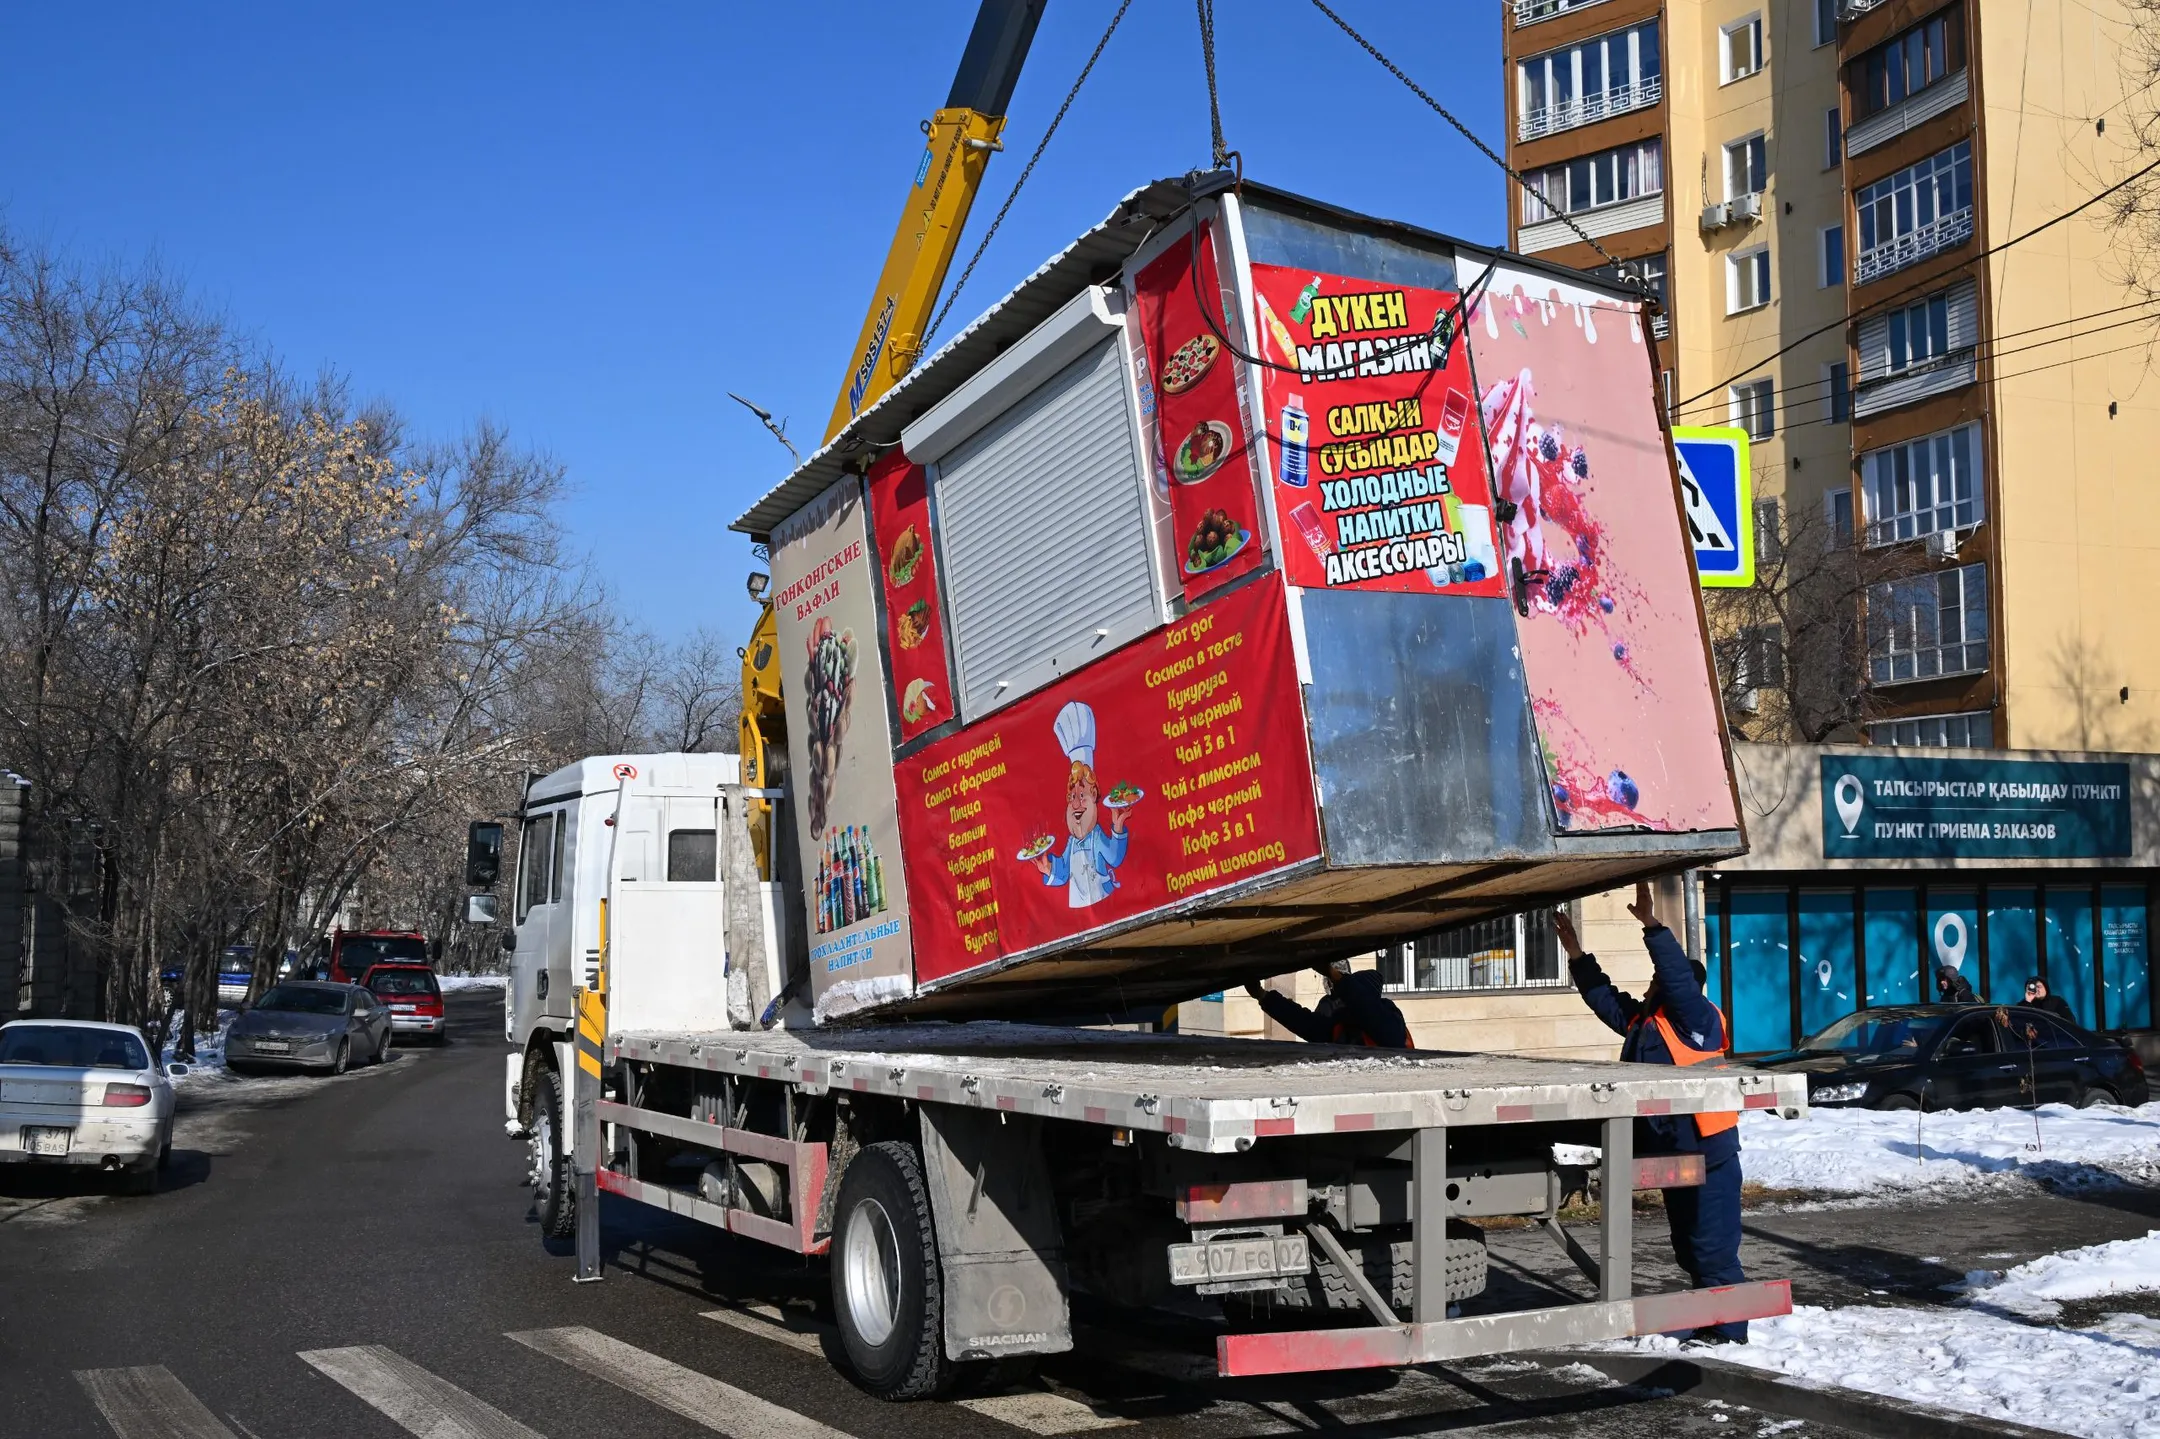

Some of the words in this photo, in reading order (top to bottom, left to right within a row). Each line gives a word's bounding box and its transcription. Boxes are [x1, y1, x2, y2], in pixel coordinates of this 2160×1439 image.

[937, 170, 947, 190] STAND
[944, 152, 954, 173] UNDER
[949, 140, 958, 154] THE
[1297, 334, 1432, 384] МАГАЗИН
[1327, 399, 1422, 437] САЛҚЫН
[1318, 431, 1439, 474] СУСЫНДАР
[1320, 464, 1449, 512] ХОЛОДНЫЕ
[1337, 500, 1443, 546] НАПИТКИ
[774, 540, 862, 612] ГОНКОНГСКИЕ
[1326, 533, 1467, 586] АКСЕССУАРЫ
[796, 580, 841, 621] ВАФЛИ
[1165, 627, 1188, 650] Хот
[1190, 614, 1214, 642] дог
[1145, 656, 1195, 688] Сосиска
[1197, 650, 1205, 666] в
[1207, 632, 1243, 660] тесте
[1167, 670, 1228, 711] Кукуруза
[1162, 715, 1188, 740] Чай
[1190, 691, 1243, 728] черный
[922, 761, 950, 784] Самса
[951, 757, 957, 770] с
[957, 733, 1002, 770] курицей
[1175, 740, 1202, 765] Чай
[1203, 734, 1213, 755] 3
[1216, 735, 1225, 750] в
[1227, 725, 1235, 745] 1
[925, 786, 952, 808] Самса
[953, 783, 958, 795] с
[959, 762, 1007, 796] фаршем
[1161, 776, 1188, 801] Чай
[1190, 778, 1196, 791] с
[1198, 752, 1262, 789] лимоном
[1873, 779, 1986, 798] ТАПСЫРЫСТАР
[1989, 783, 2069, 803] ҚАБЫЛДАУ
[2072, 784, 2121, 800] ПУНКТІ
[949, 800, 981, 824] Пицца
[1168, 804, 1205, 831] Кофе
[1207, 779, 1262, 816] черный
[948, 824, 987, 850] Беляши
[1182, 829, 1219, 856] Кофе
[1222, 821, 1232, 842] 3
[1234, 822, 1245, 837] в
[1246, 812, 1255, 833] 1
[1874, 822, 1924, 839] ПУНКТ
[1929, 823, 1991, 839] ПРИЕМА
[1993, 823, 2057, 840] ЗАКАЗОВ
[947, 848, 995, 876] Чебуреки
[1166, 858, 1218, 894] Горячий
[1220, 841, 1286, 874] шоколад
[956, 876, 991, 903] Курник
[956, 900, 999, 928] Пирожки
[810, 919, 900, 962] ПРОХЛАДИТЕЛЬНЫЕ
[828, 947, 873, 973] НАПИТКИ
[964, 929, 999, 954] Бургер
[30, 1140, 43, 1151] 05
[44, 1143, 65, 1152] BAS
[46, 1128, 67, 1140] 371
[1176, 1265, 1190, 1276] KZ
[1195, 1246, 1236, 1276] 907
[1244, 1251, 1271, 1271] FG
[1278, 1243, 1306, 1267] 02
[969, 1332, 1048, 1347] SHACMAN
